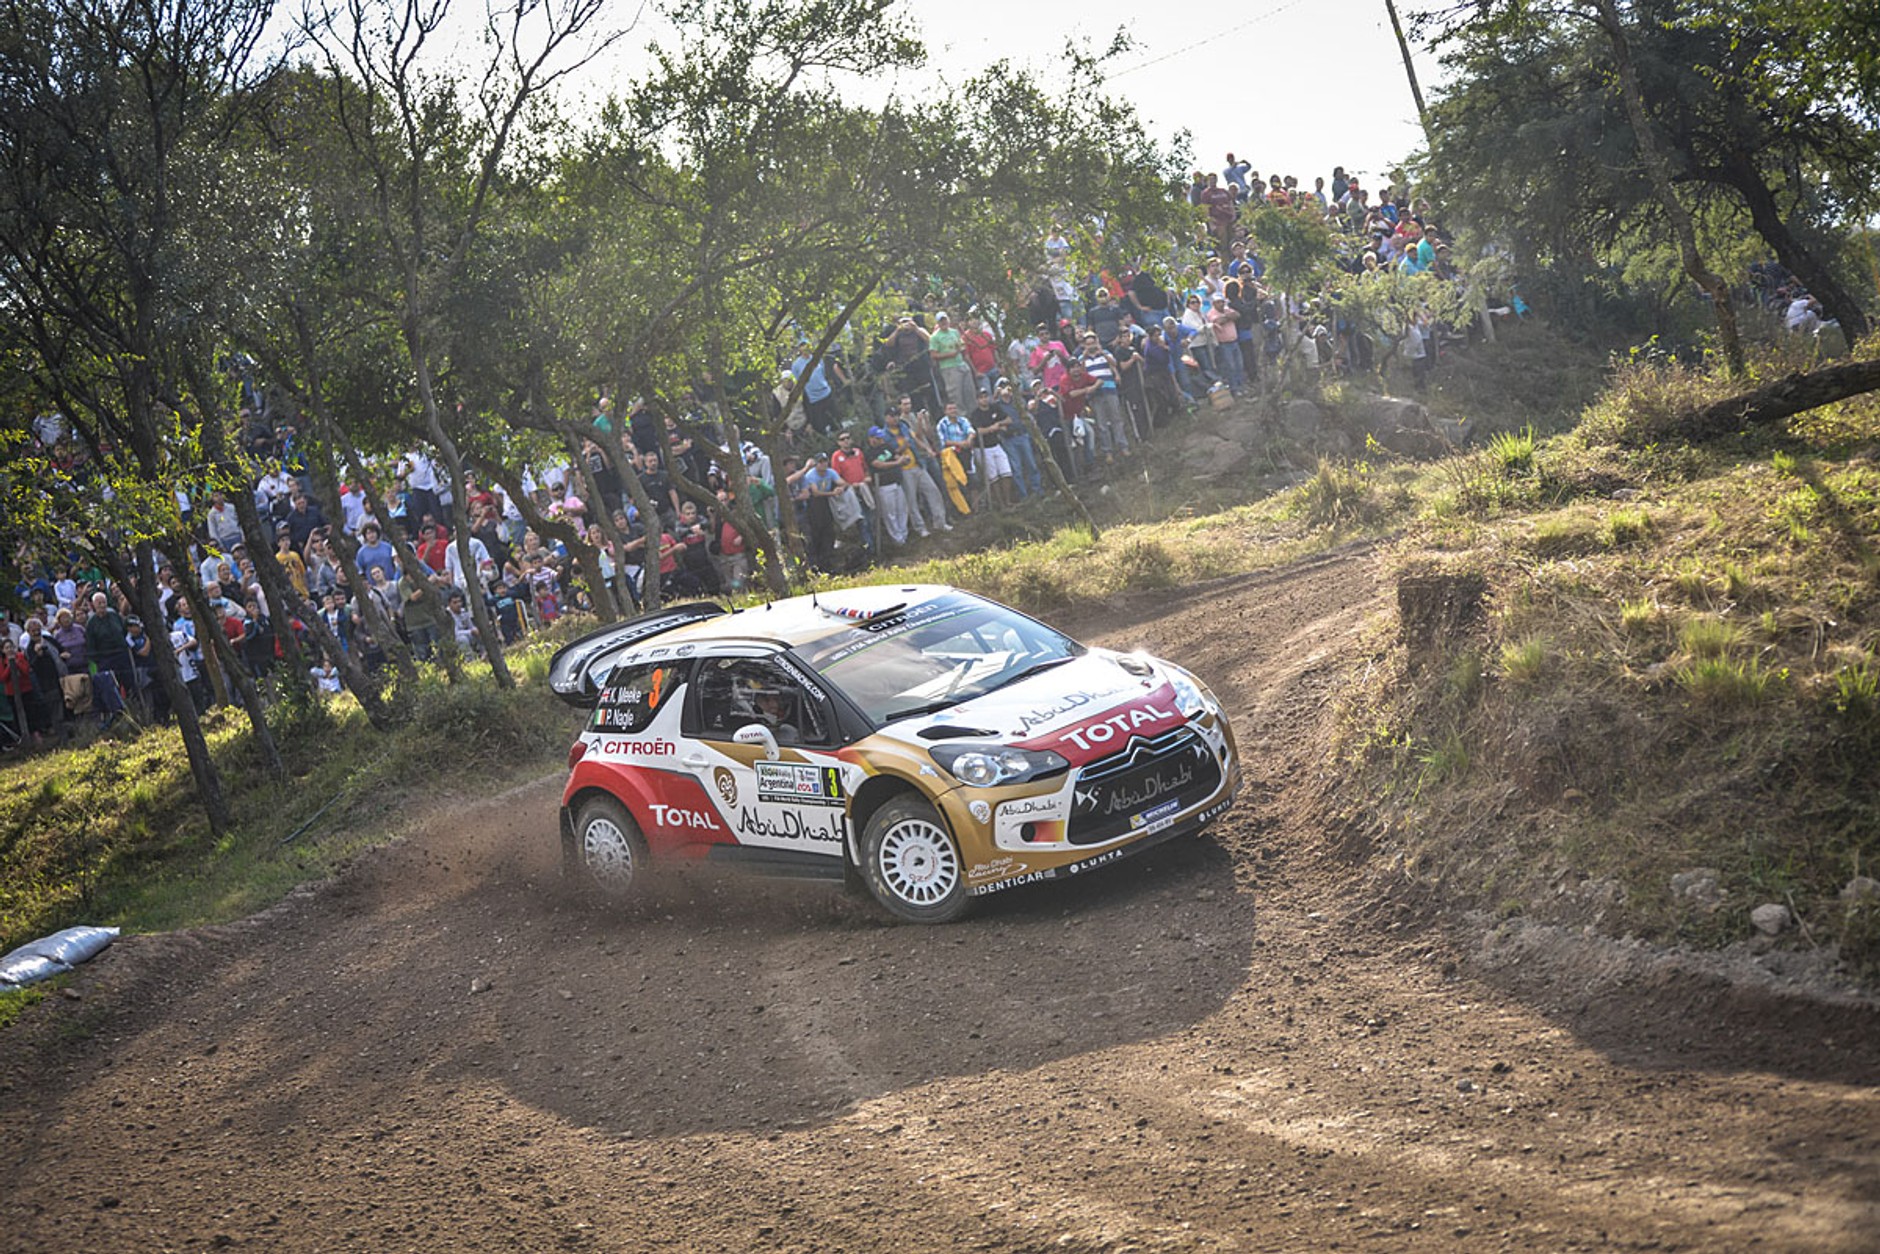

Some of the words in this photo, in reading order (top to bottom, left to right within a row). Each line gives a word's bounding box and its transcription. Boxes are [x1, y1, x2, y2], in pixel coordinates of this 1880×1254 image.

[649, 668, 663, 709] 3
[613, 709, 634, 730] Nagle
[1059, 703, 1174, 751] TOTAL
[741, 732, 764, 740] TOTAL
[828, 768, 839, 798] 3
[648, 804, 720, 830] TOTAL
[974, 871, 1044, 896] IDENTICAR
